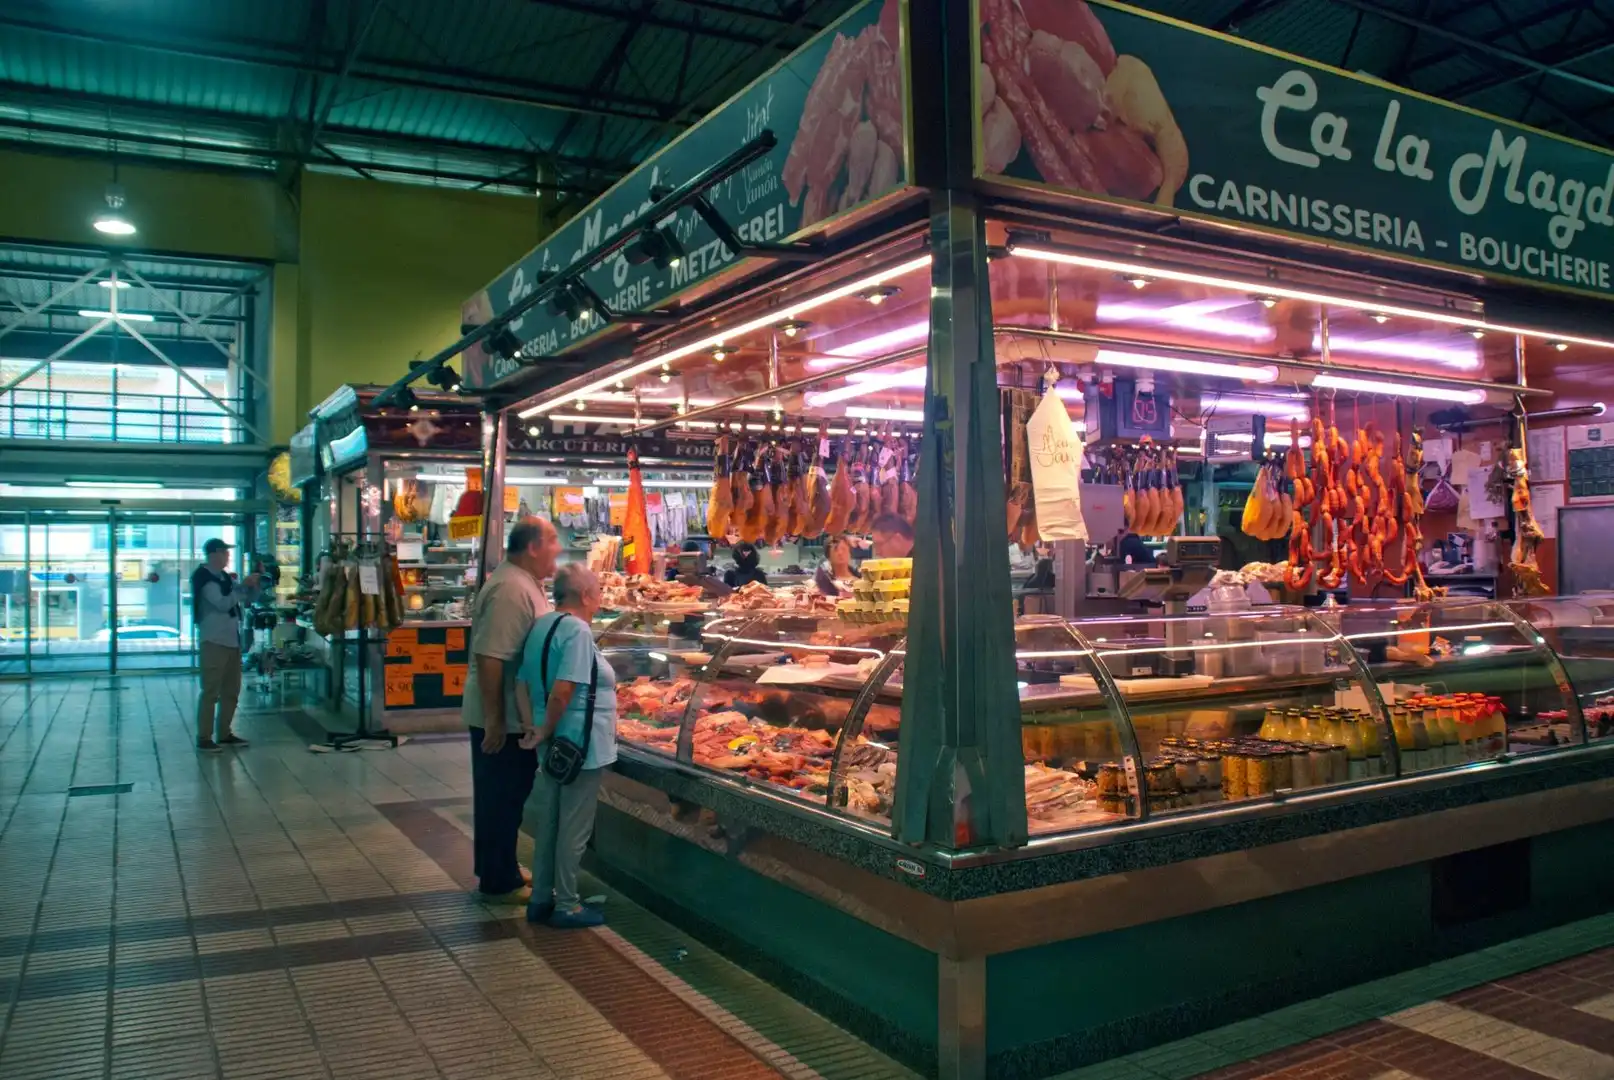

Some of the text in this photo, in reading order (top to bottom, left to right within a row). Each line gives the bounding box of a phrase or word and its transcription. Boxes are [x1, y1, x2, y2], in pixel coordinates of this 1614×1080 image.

[1256, 70, 1352, 169] Ca
[1374, 99, 1434, 181] la
[1189, 173, 1425, 252] CARNISSERIA
[1459, 231, 1611, 290] BOUCHERIE
